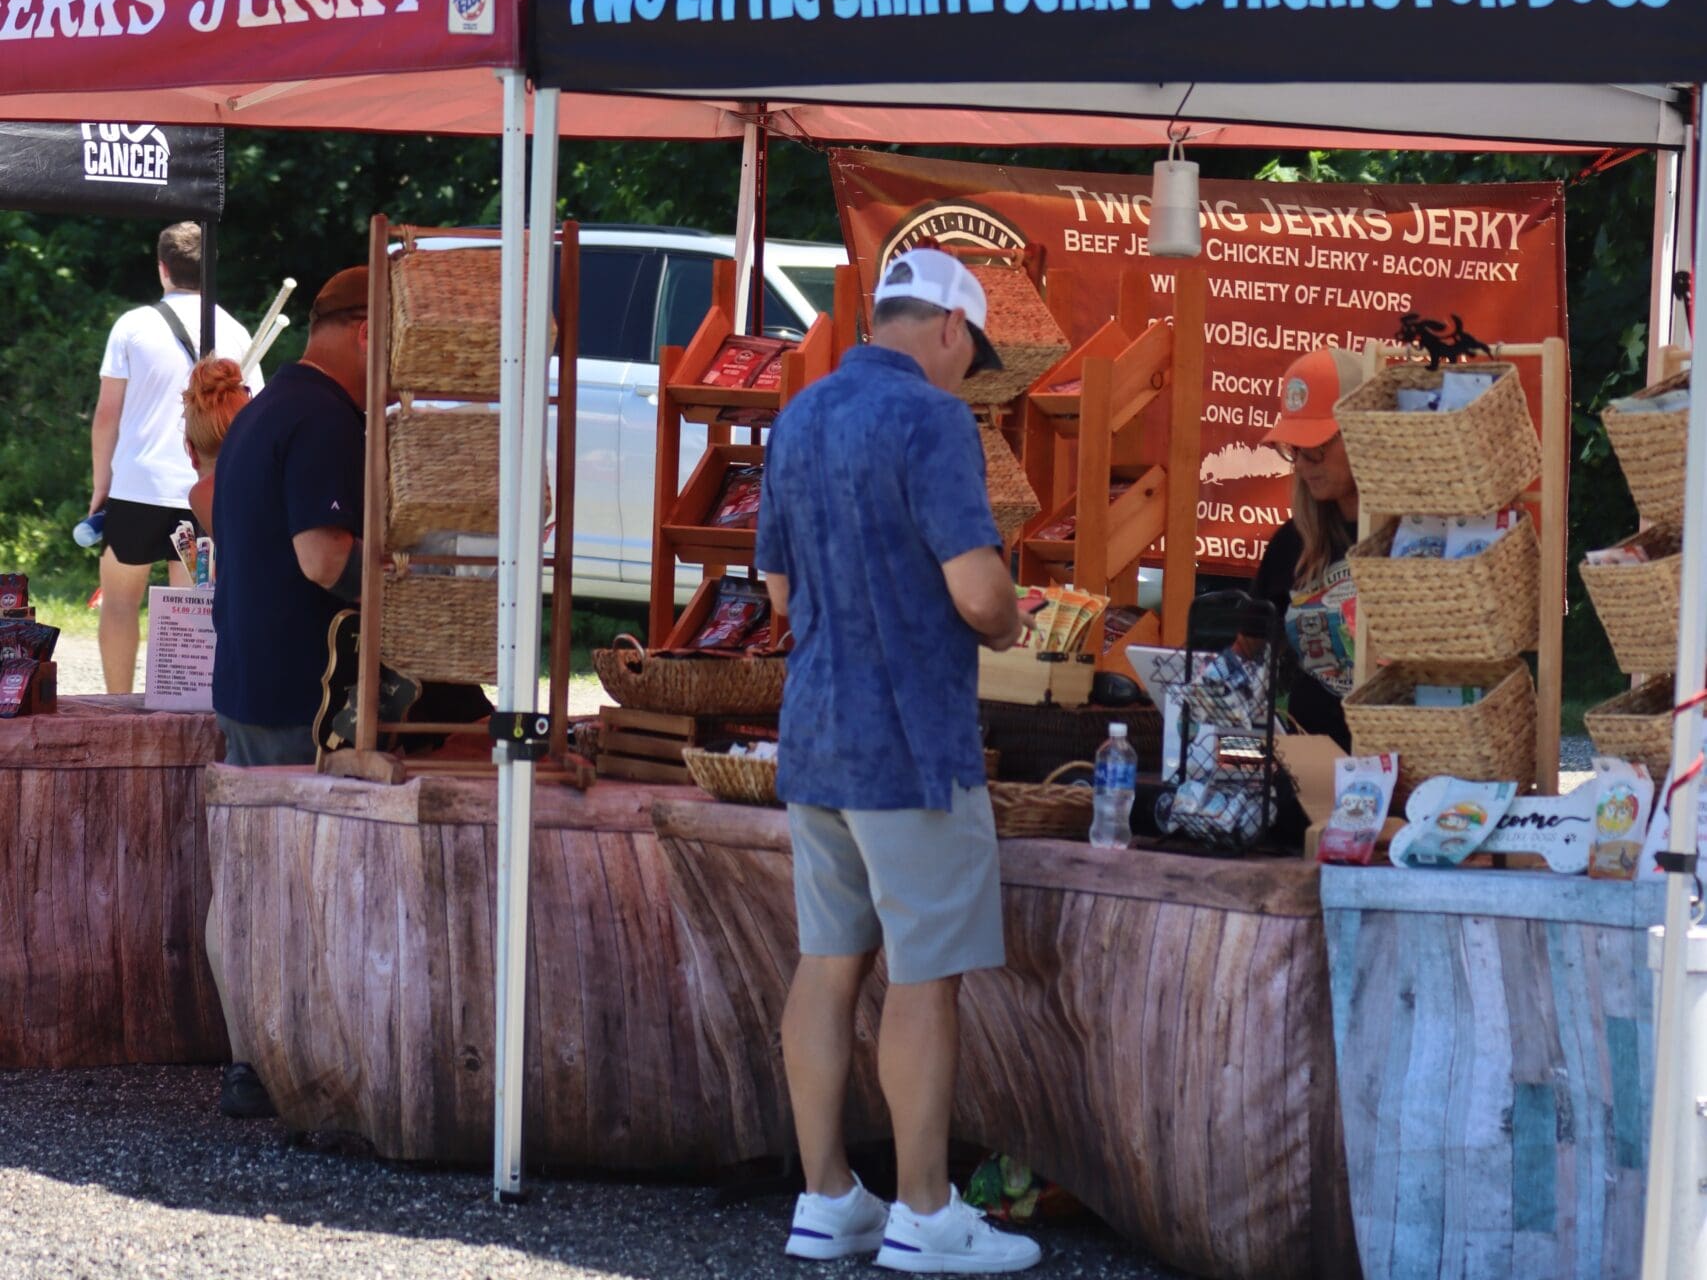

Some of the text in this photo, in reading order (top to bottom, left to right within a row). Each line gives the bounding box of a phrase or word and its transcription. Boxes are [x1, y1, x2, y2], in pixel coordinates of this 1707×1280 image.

[83, 140, 169, 179] CANCER
[888, 215, 1019, 266] OURMET HANDM
[1063, 228, 1120, 255] BEEF
[1199, 198, 1249, 233] IG
[1259, 197, 1393, 243] JERKS
[1402, 201, 1530, 251] JERKY
[1205, 237, 1300, 268] CHICKEN
[1304, 245, 1370, 272] JERKY
[1382, 254, 1452, 279] BACON
[1454, 259, 1520, 282] JERKY
[1207, 277, 1291, 303] VARIETY
[1294, 284, 1321, 305] OF
[1324, 286, 1412, 313] FLAVORS
[1203, 320, 1340, 356] OBIGJERKS
[1211, 370, 1275, 397] ROCKY
[1248, 405, 1282, 428] ISLA
[1326, 567, 1351, 585] LITT
